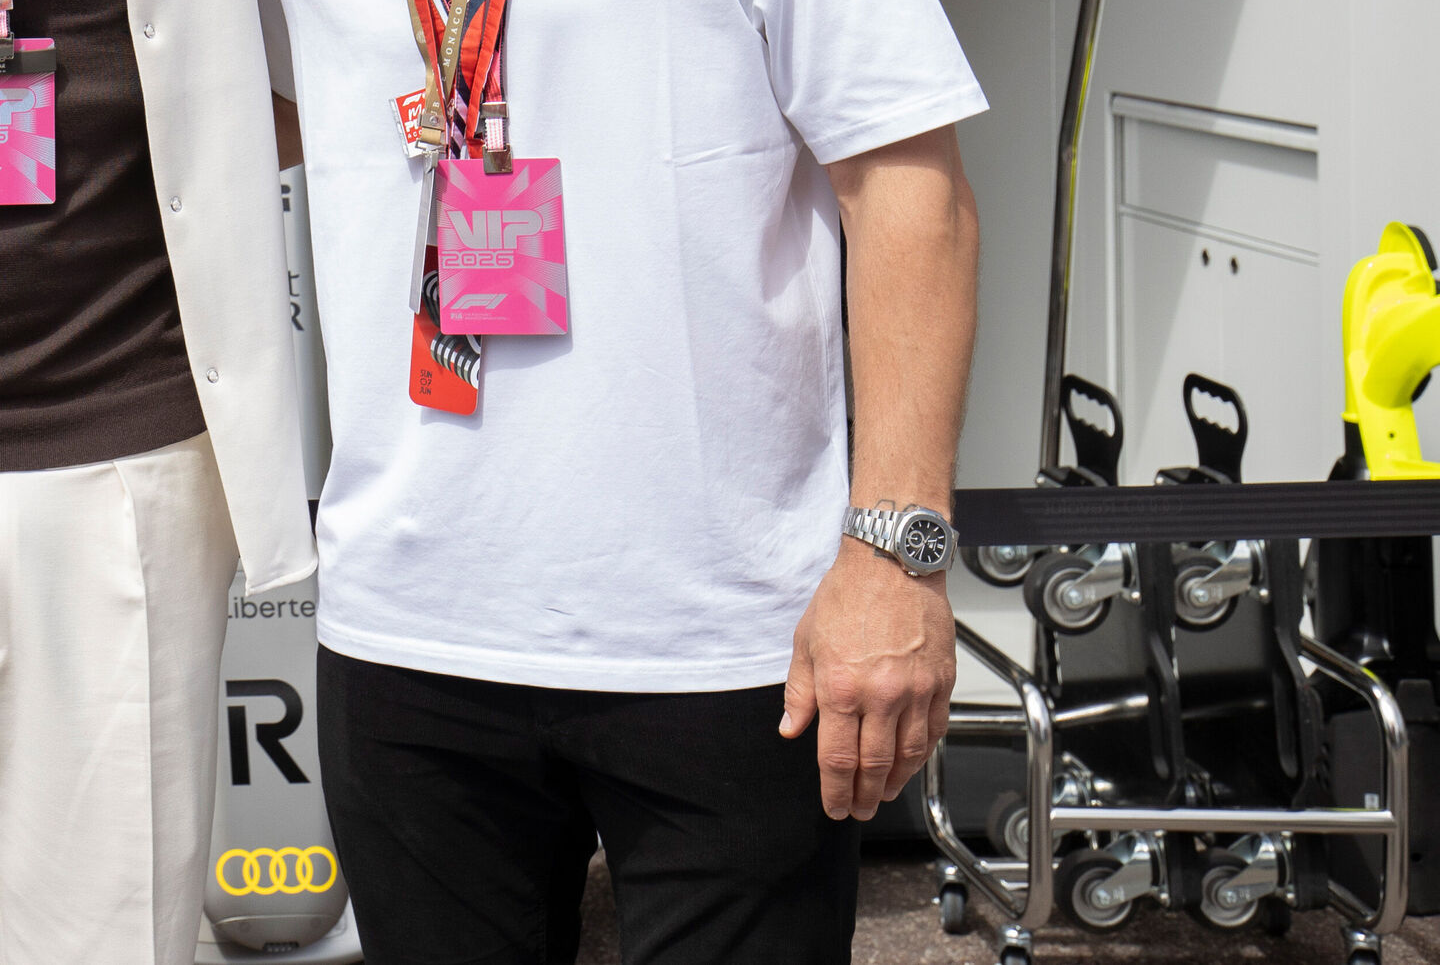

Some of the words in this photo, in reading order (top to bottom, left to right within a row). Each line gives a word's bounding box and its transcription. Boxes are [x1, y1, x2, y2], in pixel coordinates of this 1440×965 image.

[443, 6, 463, 68] MONACO
[446, 210, 543, 250] VIP
[441, 250, 515, 270] 2026
[228, 596, 316, 619] iberte
